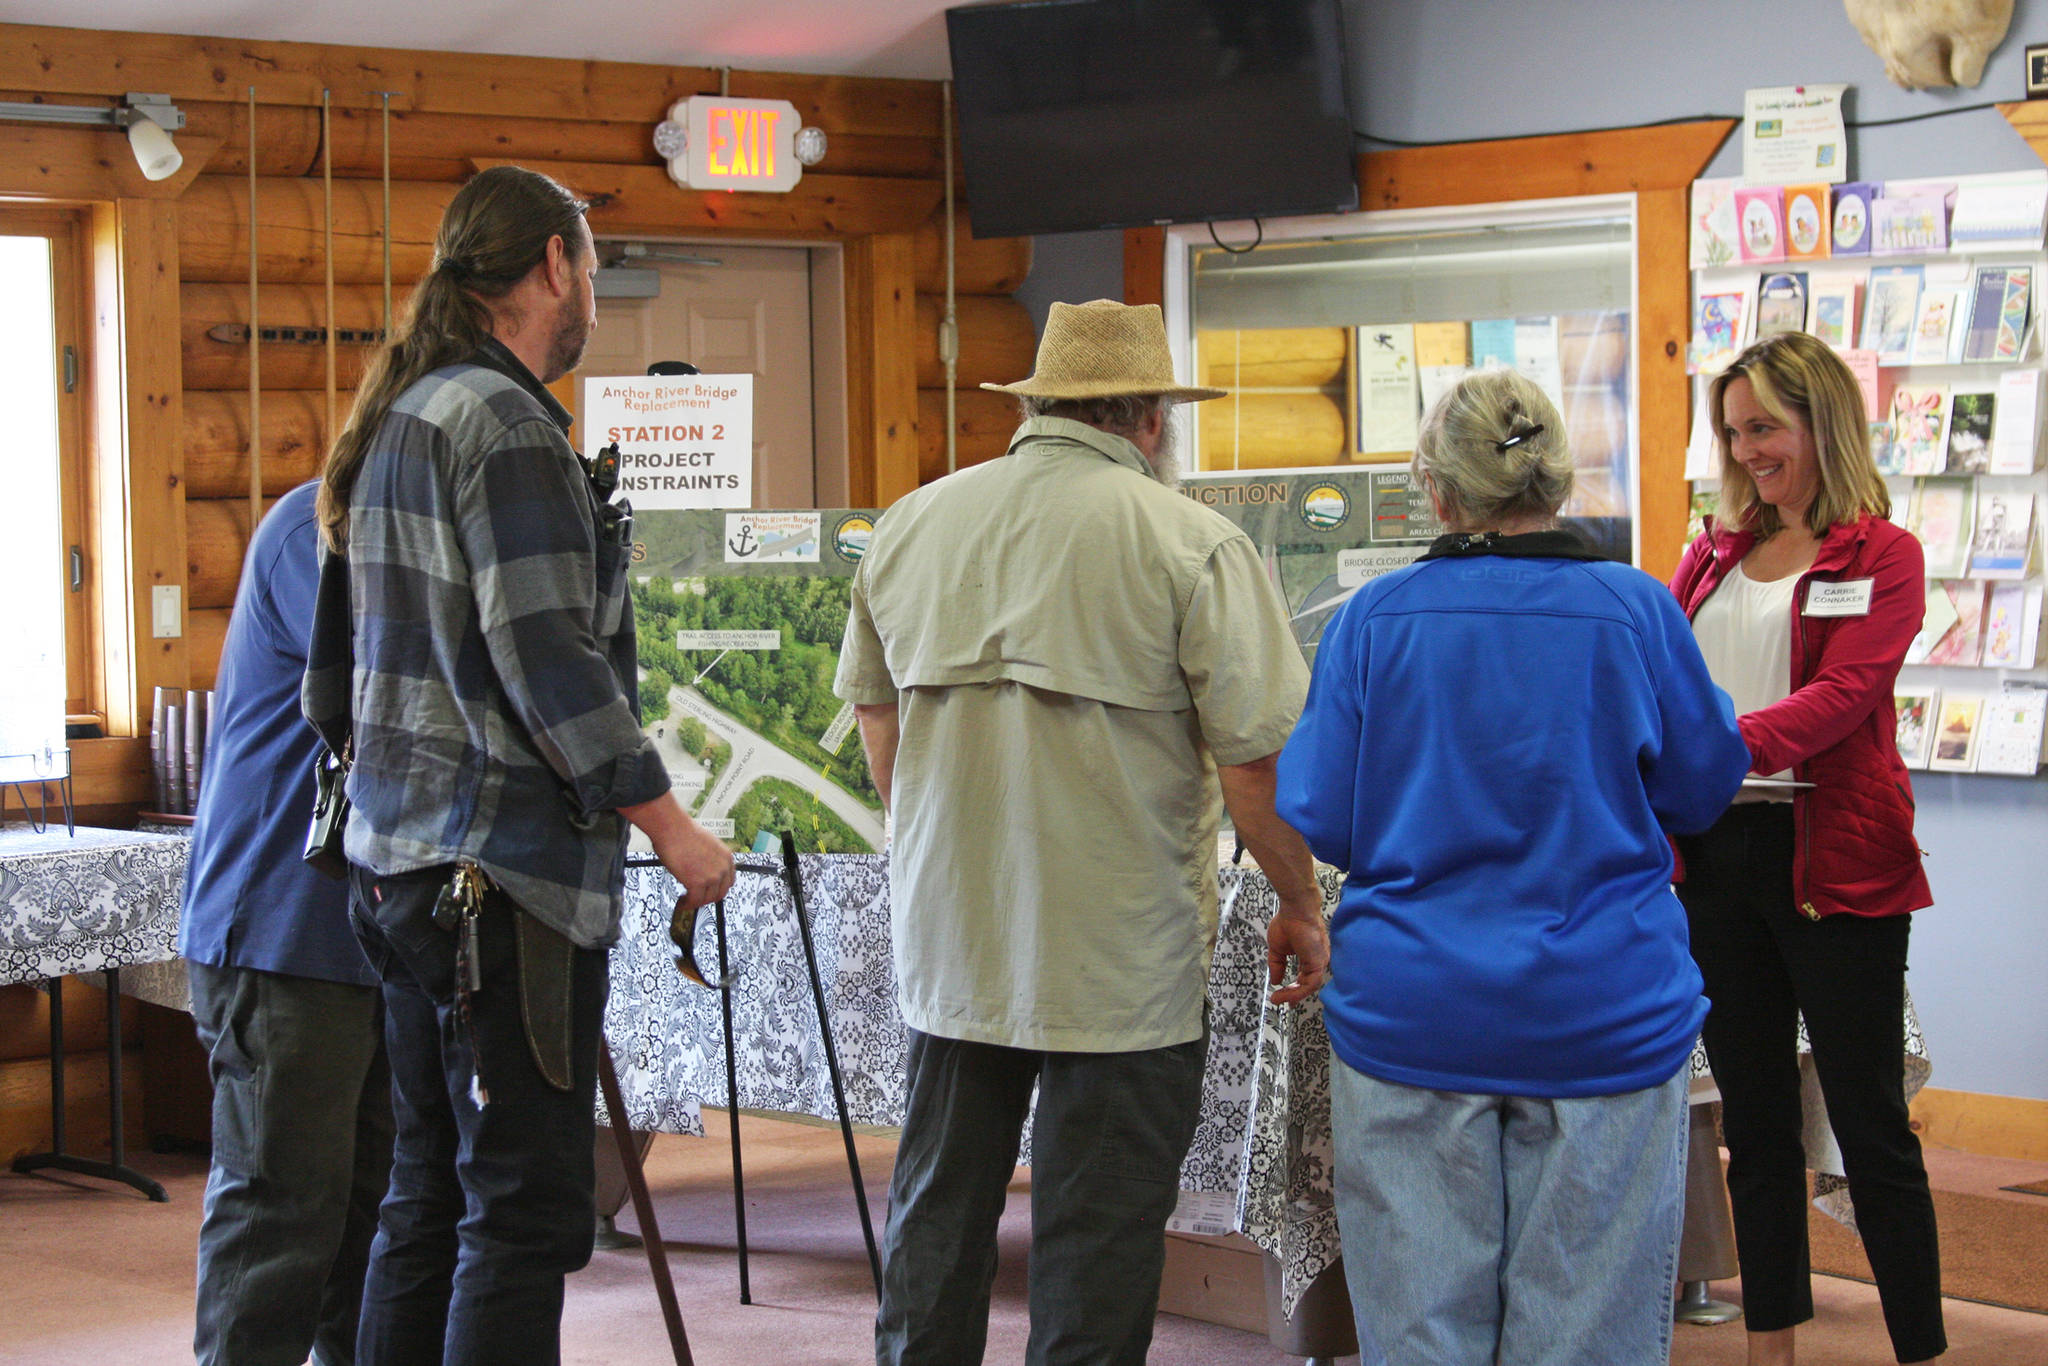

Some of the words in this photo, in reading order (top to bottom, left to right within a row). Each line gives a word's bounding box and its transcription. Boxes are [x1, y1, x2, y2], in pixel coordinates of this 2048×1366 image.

[707, 107, 781, 178] EXIT
[602, 386, 651, 400] Anchor
[655, 384, 690, 400] River
[695, 384, 738, 401] Bridge
[624, 398, 711, 415] Replacement
[608, 425, 703, 443] STATION
[712, 424, 724, 440] 2
[622, 453, 715, 468] PROJECT
[1377, 474, 1408, 483] LEGEND
[741, 515, 769, 523] Anchor
[770, 515, 791, 523] River
[793, 515, 818, 525] Bridge
[1344, 558, 1374, 567] BRIDGE
[1376, 556, 1409, 566] CLOSED
[1823, 587, 1856, 596] CARRIE
[1814, 595, 1864, 604] CONNAKER
